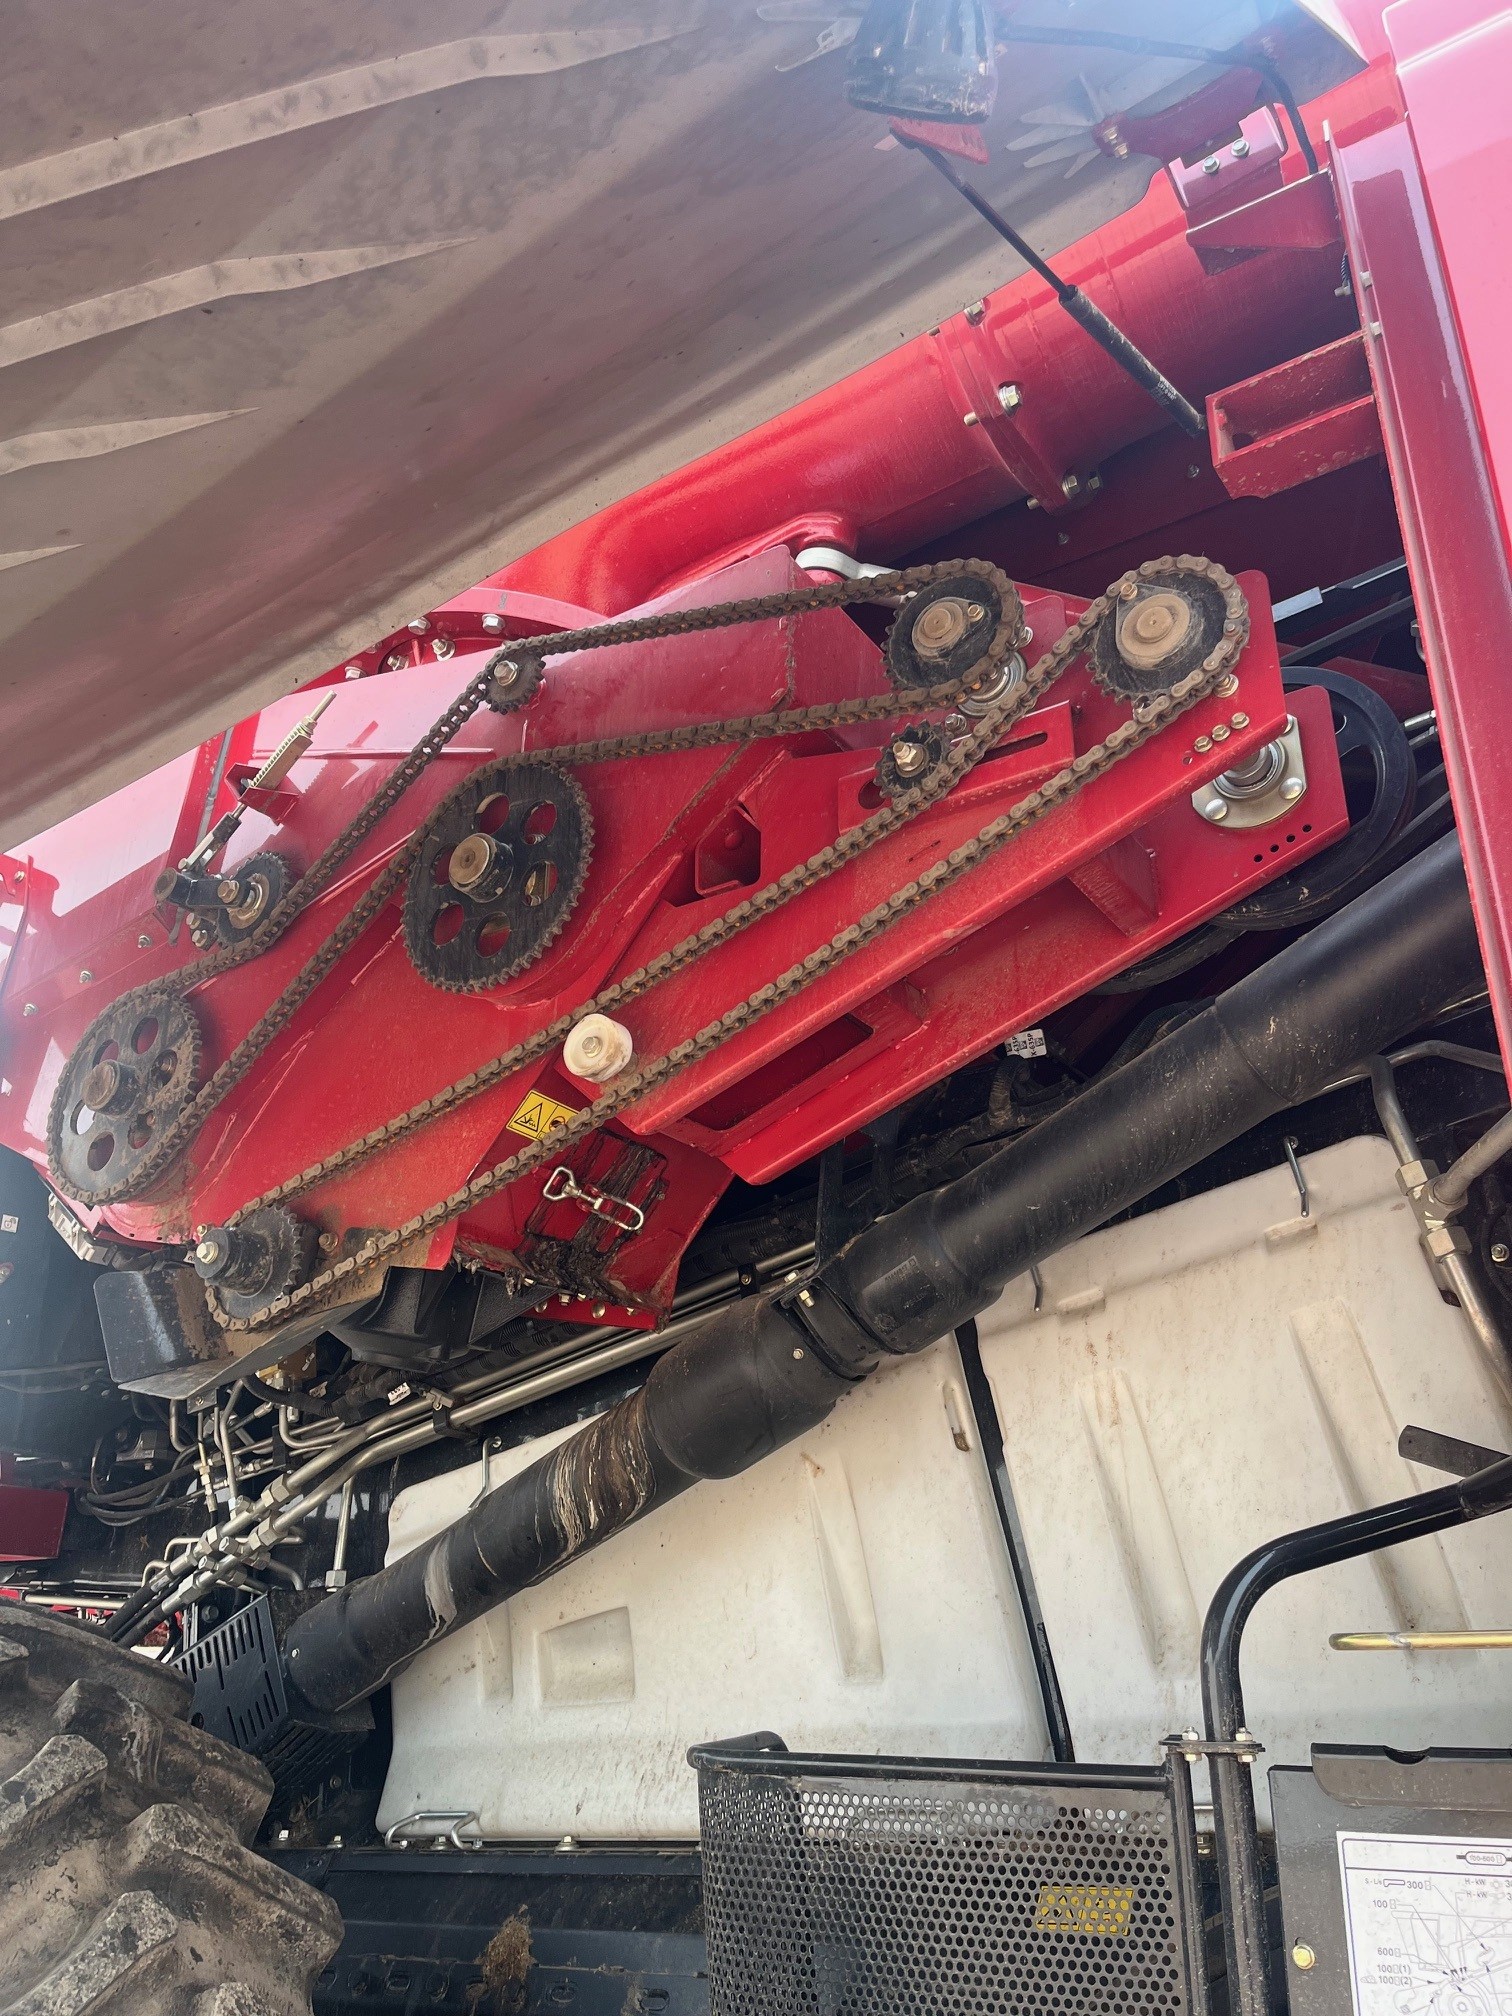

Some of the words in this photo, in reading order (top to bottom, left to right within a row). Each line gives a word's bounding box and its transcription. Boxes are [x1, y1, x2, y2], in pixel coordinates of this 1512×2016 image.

[1407, 1881, 1423, 1889] 300
[1373, 1900, 1388, 1908] 100
[1378, 1948, 1393, 1956] 600
[1378, 1965, 1392, 1973] 100
[1379, 1976, 1394, 1984] 100
